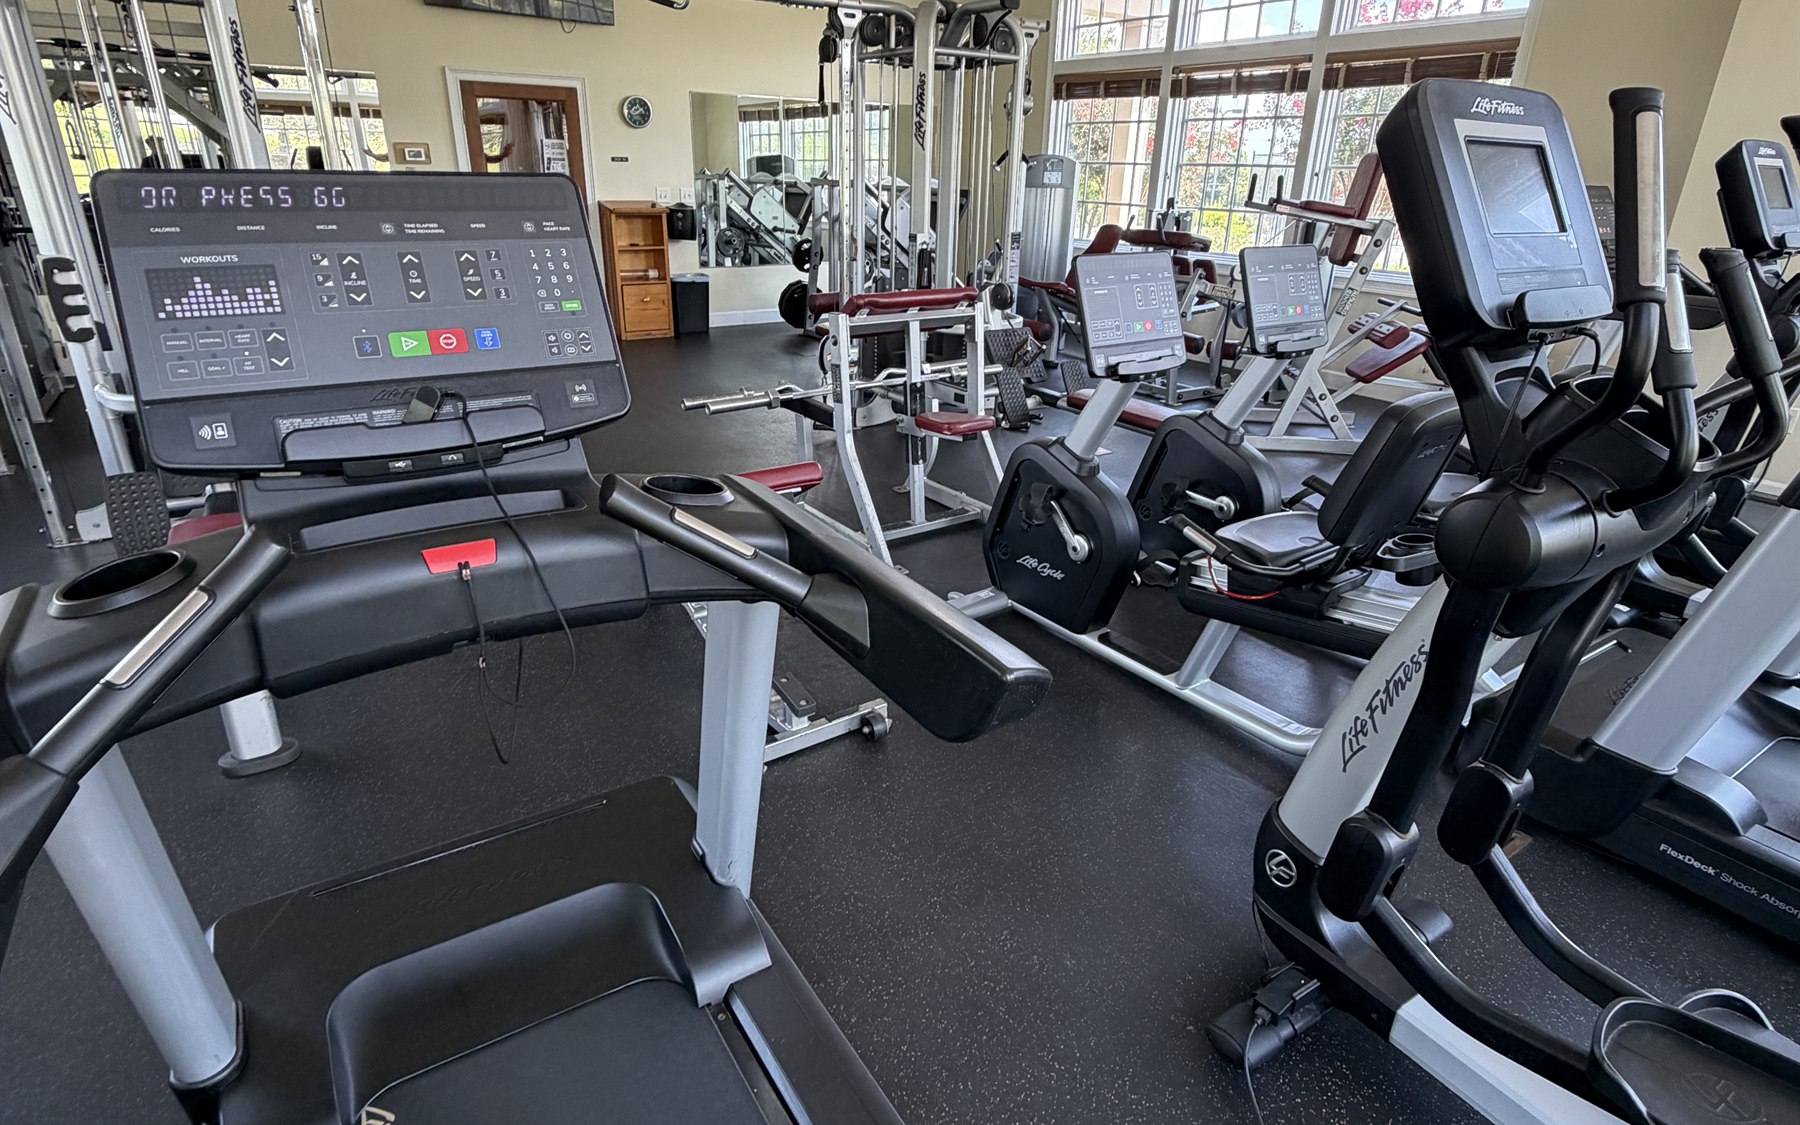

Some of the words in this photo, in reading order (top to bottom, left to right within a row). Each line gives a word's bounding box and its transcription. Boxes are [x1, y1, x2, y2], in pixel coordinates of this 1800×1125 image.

[311, 253, 322, 261] 15
[529, 249, 536, 258] 1
[544, 248, 552, 257] 2
[560, 248, 567, 257] 3
[180, 254, 239, 264] WORKOUTS
[532, 262, 539, 271] 4
[547, 261, 555, 270] 5
[563, 261, 570, 270] 6
[535, 275, 542, 284] 7
[550, 274, 558, 284] 8
[566, 274, 573, 283] 9
[553, 288, 561, 297] 0
[1016, 555, 1038, 569] Life
[1037, 563, 1065, 580] Cycle
[1659, 843, 1717, 877] FlexDeck
[1719, 872, 1759, 896] Shock
